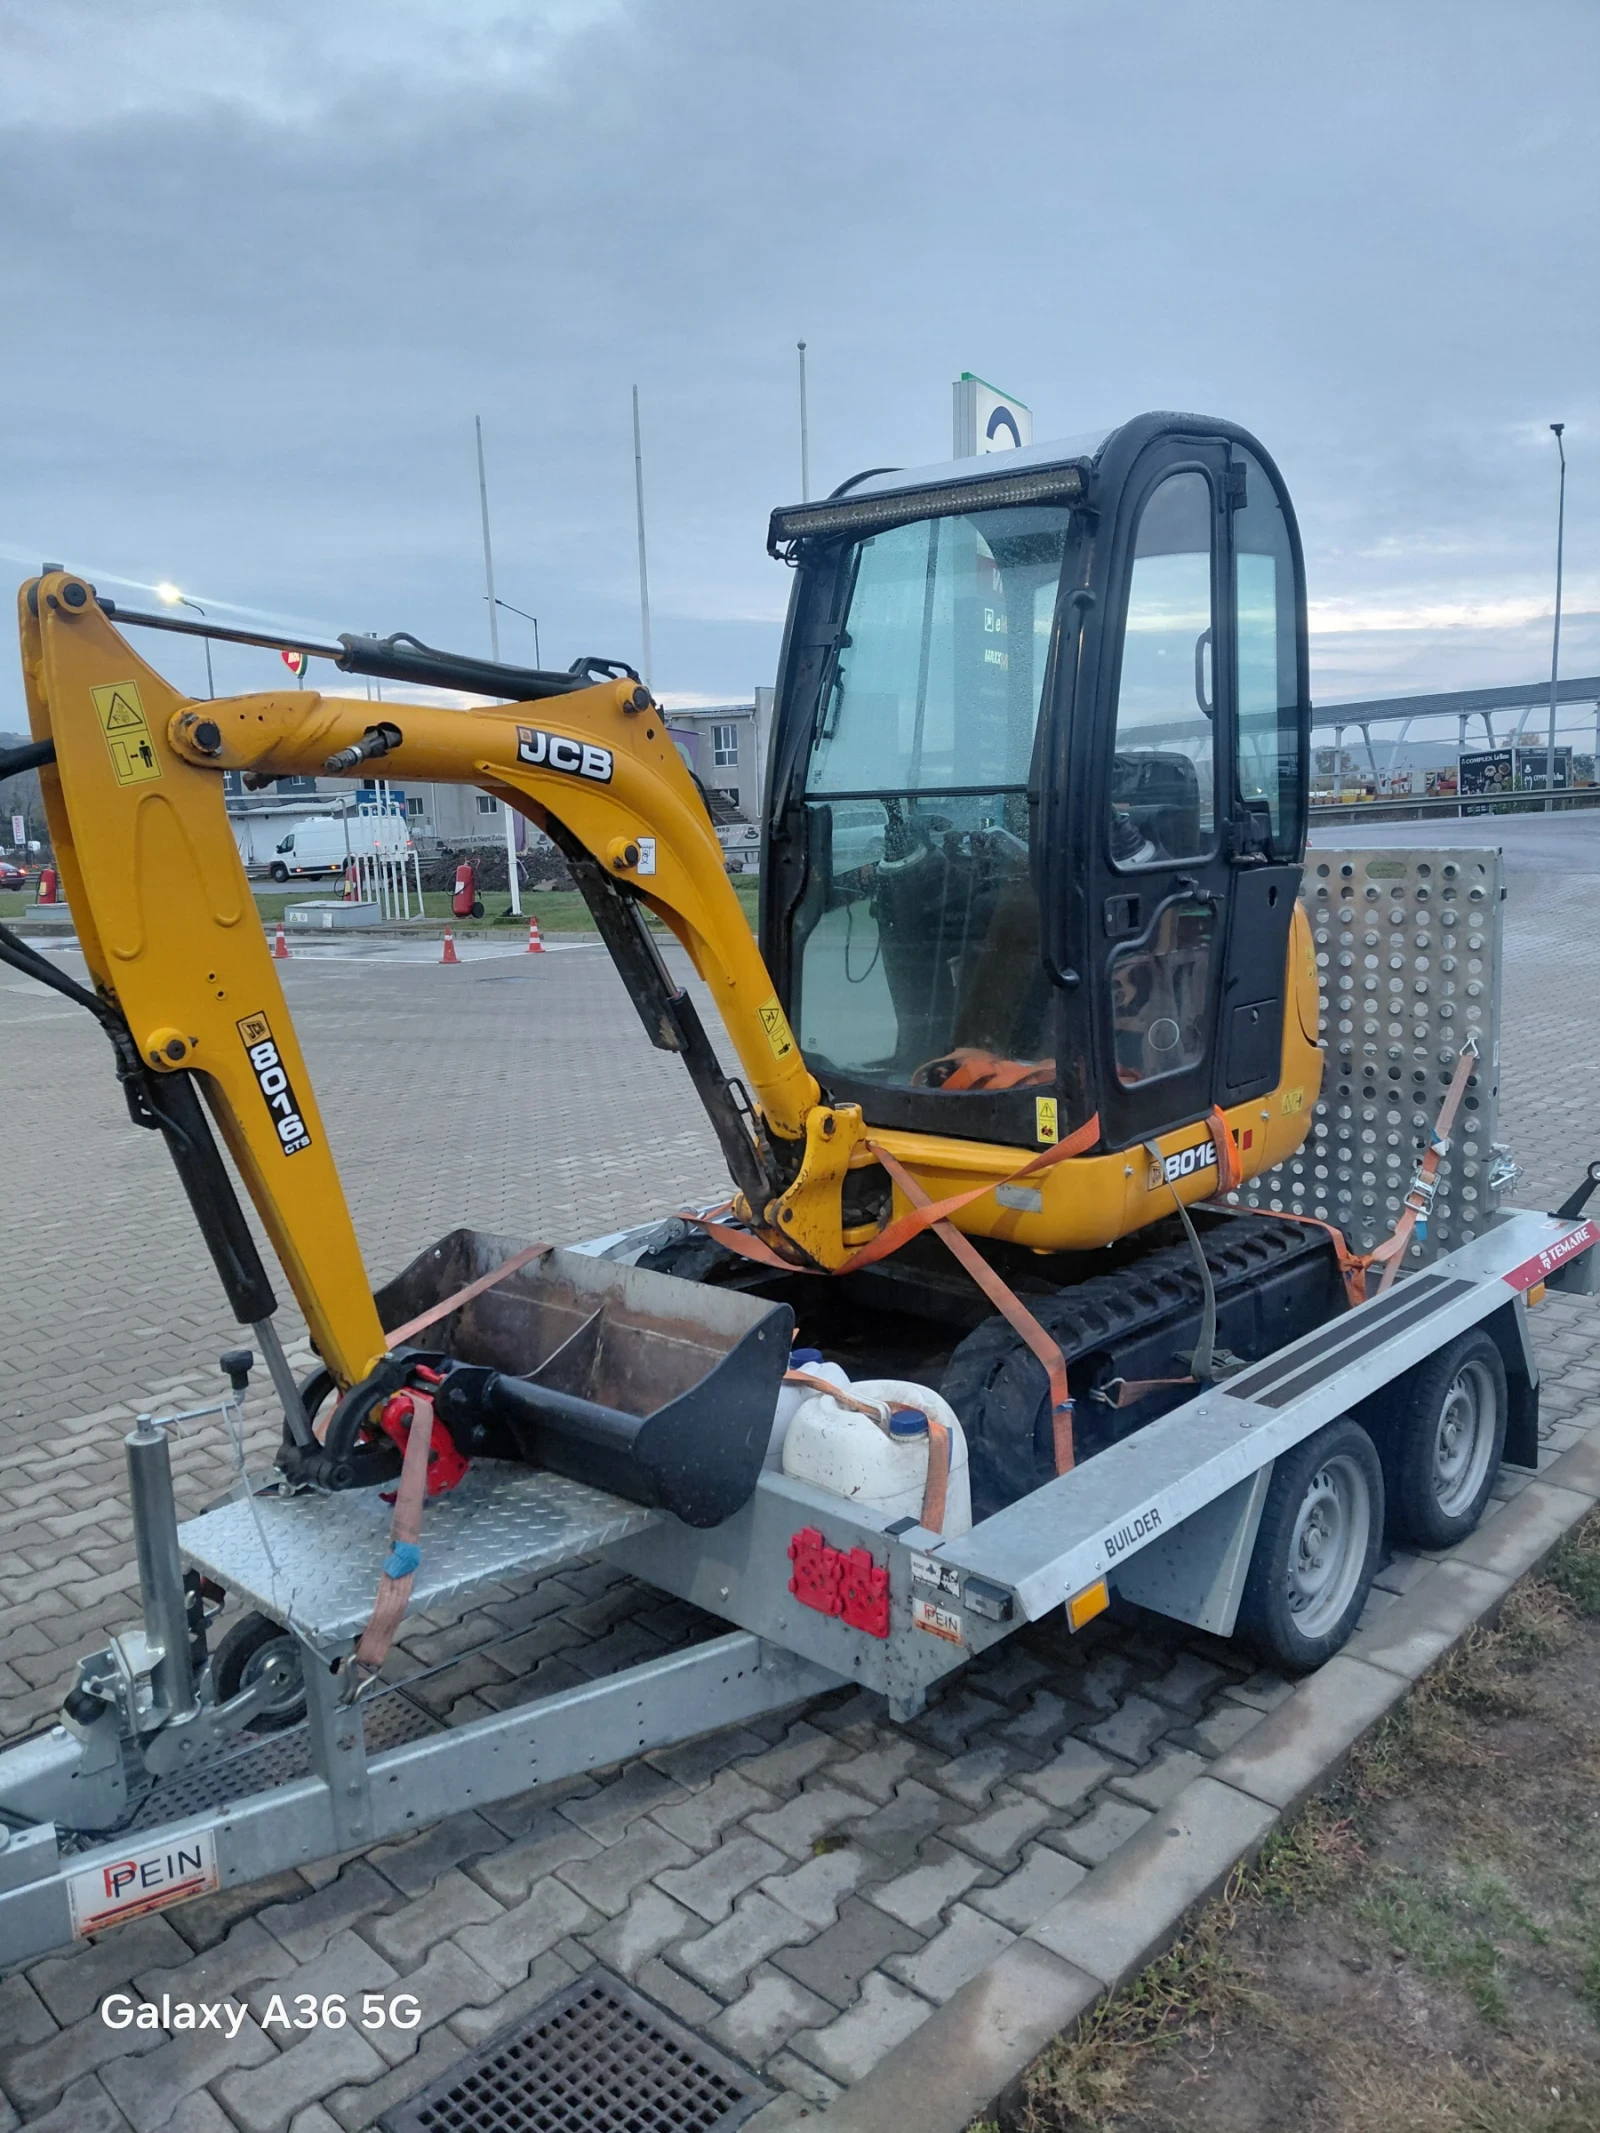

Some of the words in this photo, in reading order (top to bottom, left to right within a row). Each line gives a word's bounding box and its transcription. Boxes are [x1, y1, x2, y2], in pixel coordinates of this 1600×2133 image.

[520, 731, 613, 780] JCB
[1466, 756, 1493, 765] COMPLEX
[246, 1022, 266, 1039] JCB
[250, 1041, 305, 1142] 8016
[284, 1136, 310, 1155] CTS
[1104, 1508, 1162, 1559] BUILDER
